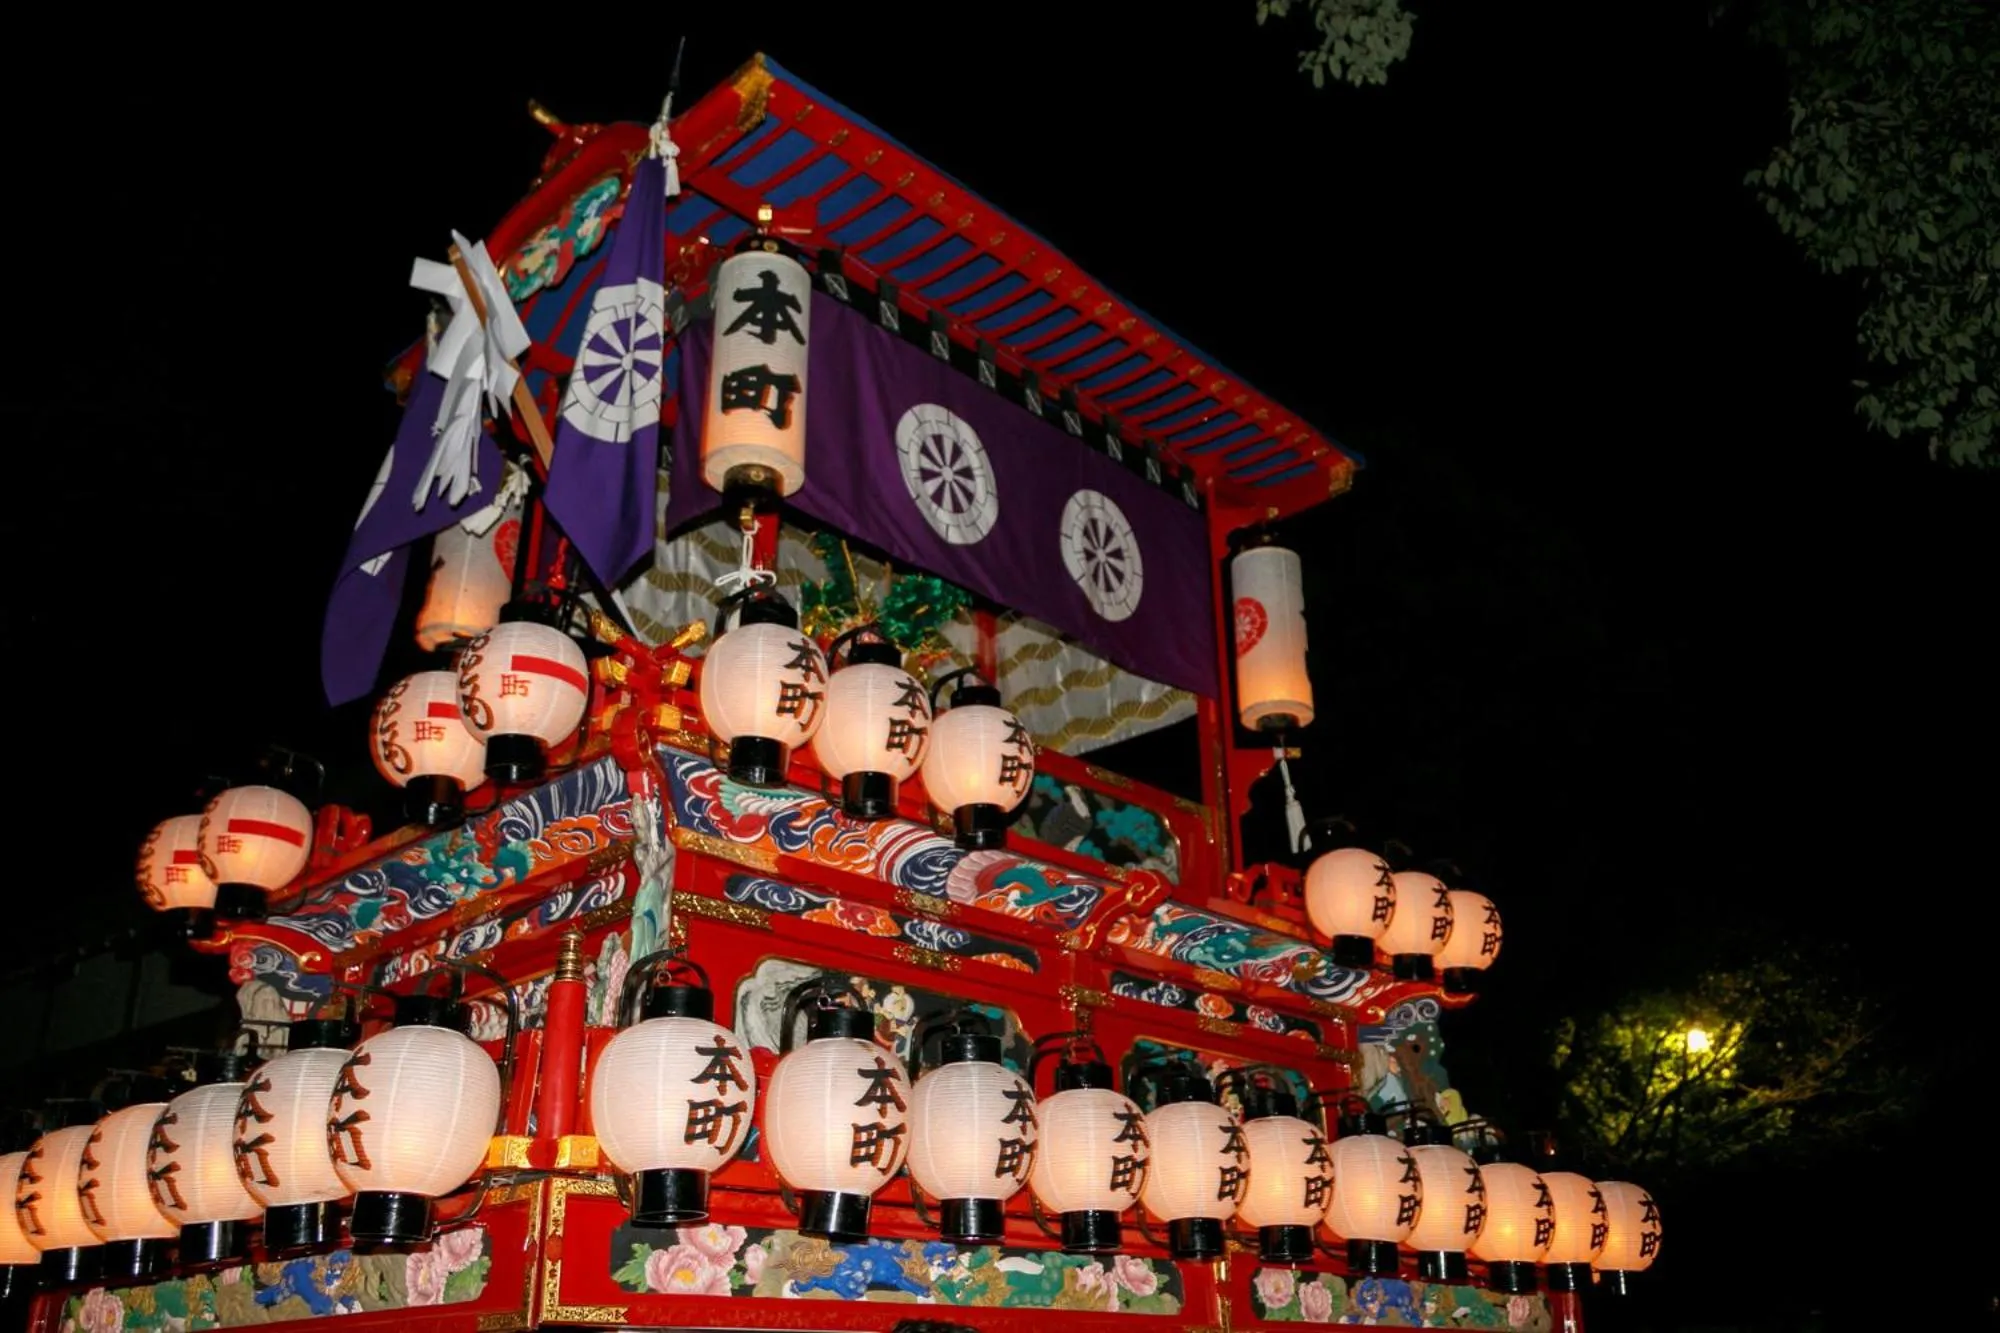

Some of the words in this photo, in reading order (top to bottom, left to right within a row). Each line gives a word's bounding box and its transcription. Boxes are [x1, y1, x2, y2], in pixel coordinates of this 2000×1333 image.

[721, 269, 806, 430] 本町
[776, 638, 827, 731] 本町
[886, 677, 930, 765] 本町
[1000, 716, 1034, 798] 本町
[1372, 860, 1396, 930] 本町
[1431, 882, 1454, 947] 本町
[1481, 901, 1501, 960] 本町
[684, 1035, 749, 1155] 本町
[849, 1056, 907, 1175] 本町
[995, 1080, 1038, 1183] 本町
[1110, 1102, 1149, 1197] 本町
[1218, 1116, 1250, 1206] 本町
[1303, 1129, 1334, 1213] 本町
[1396, 1150, 1423, 1231] 本町
[1464, 1160, 1487, 1238] 本町
[1532, 1176, 1555, 1250] 本町
[1588, 1183, 1608, 1250] 本町
[1638, 1193, 1662, 1260] 本町
